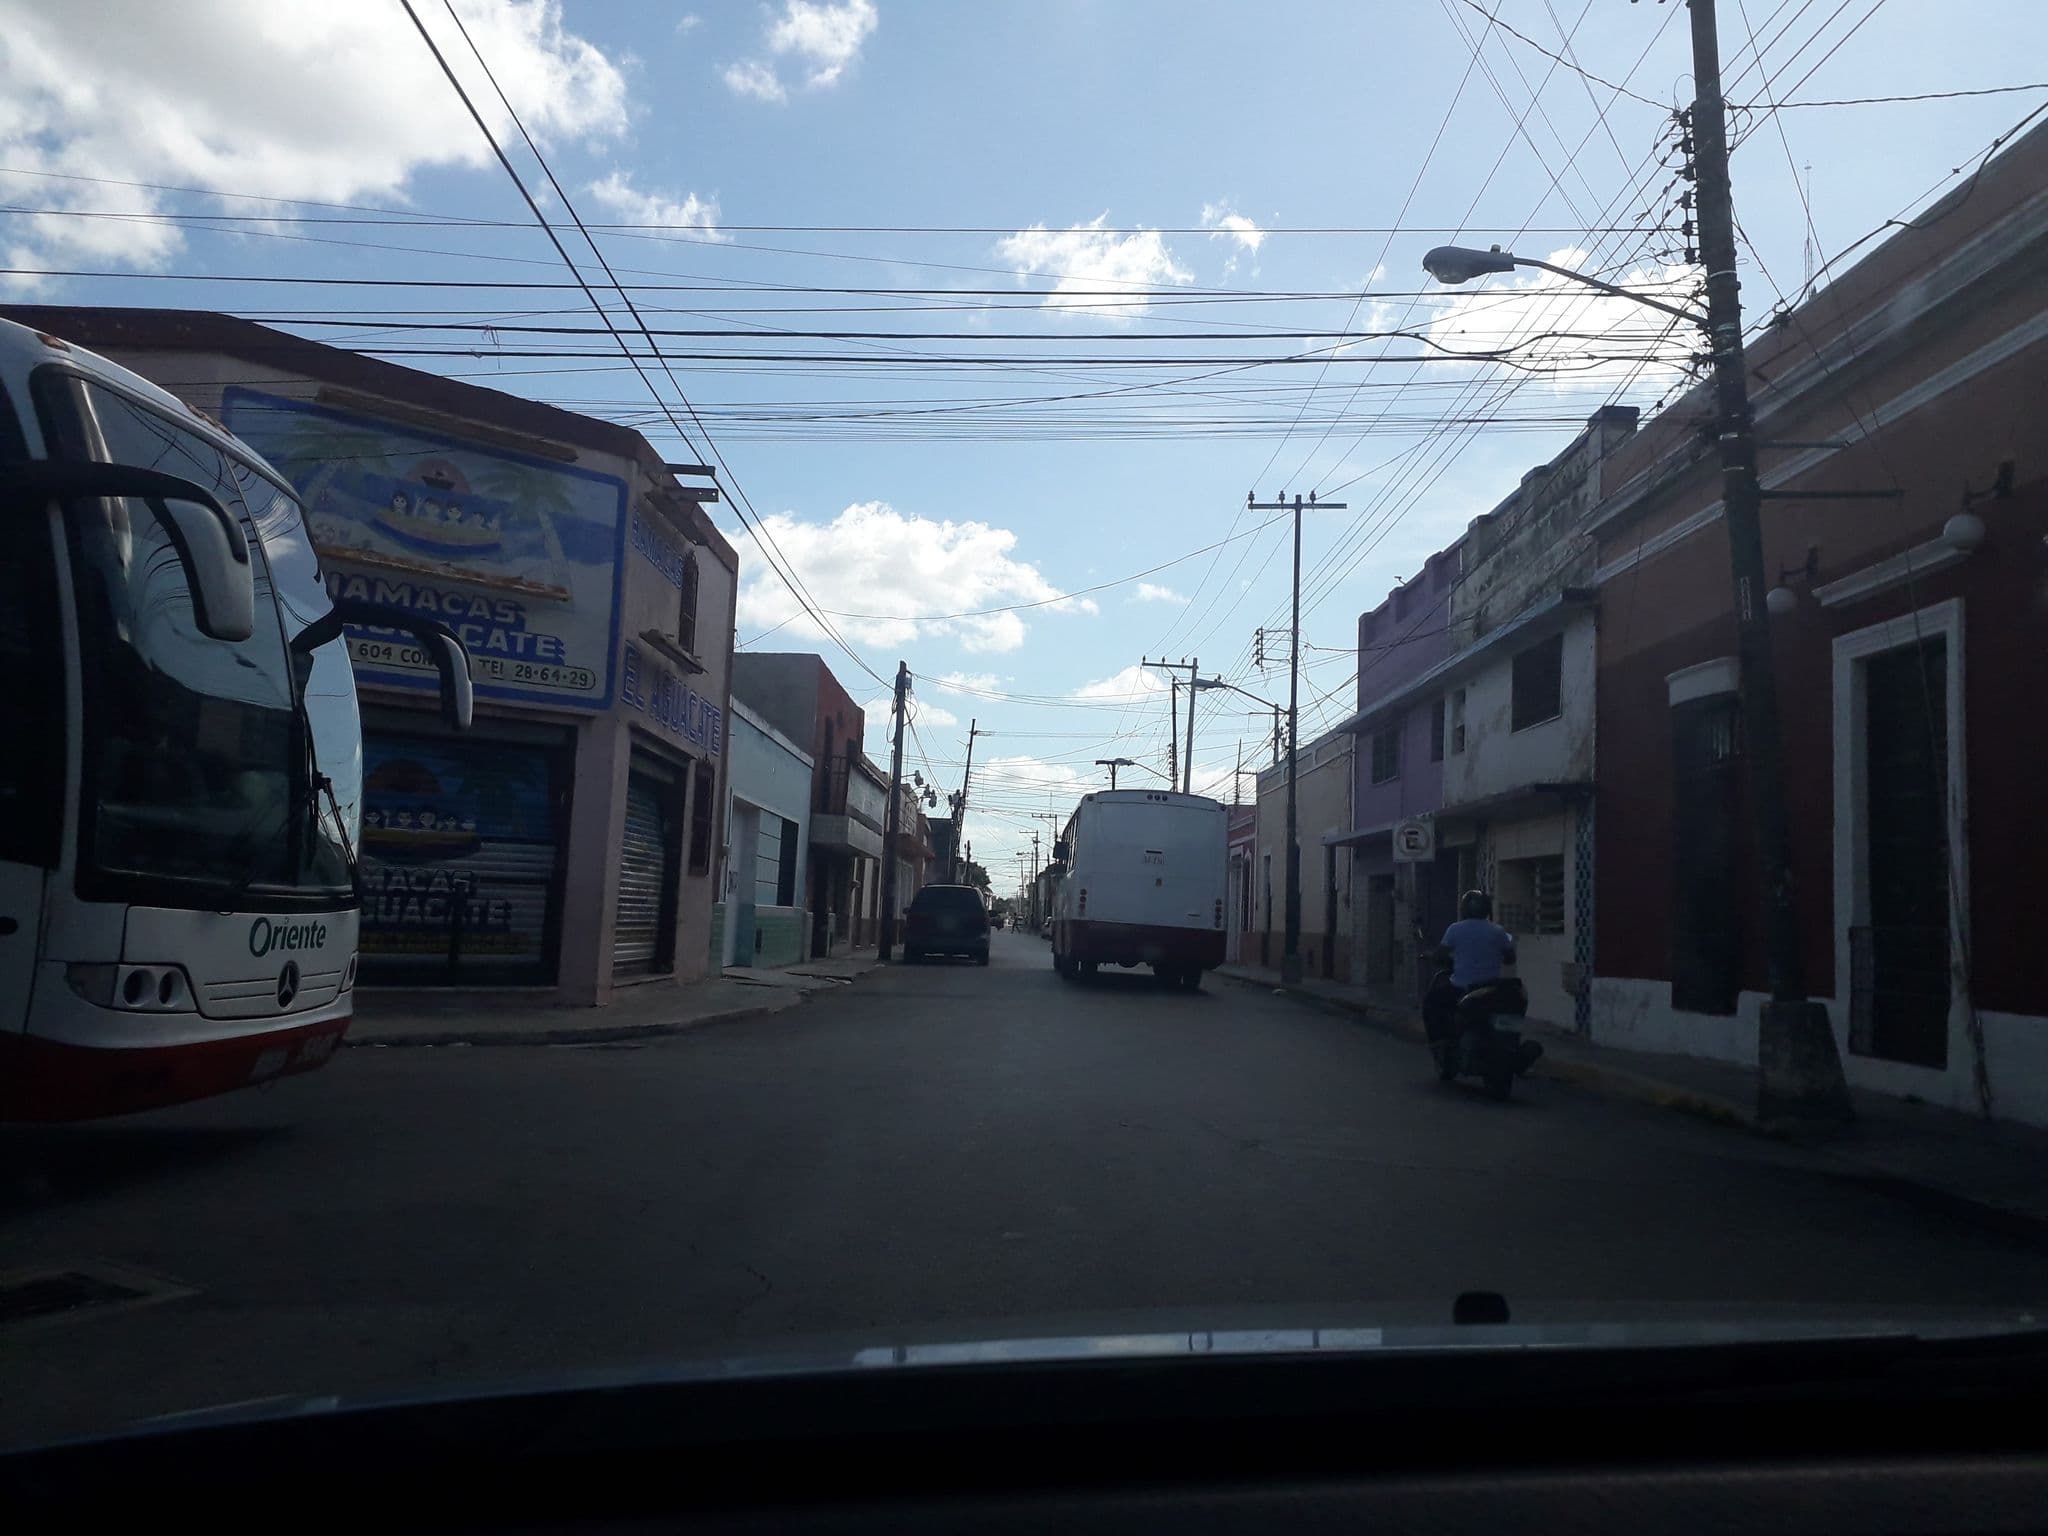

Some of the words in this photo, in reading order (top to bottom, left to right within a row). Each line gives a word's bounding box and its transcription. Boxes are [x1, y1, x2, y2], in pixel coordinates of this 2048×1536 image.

[359, 643, 392, 660] 604
[622, 640, 644, 712] EL
[649, 672, 720, 757] AGUACATE
[249, 917, 327, 957] Oriente
